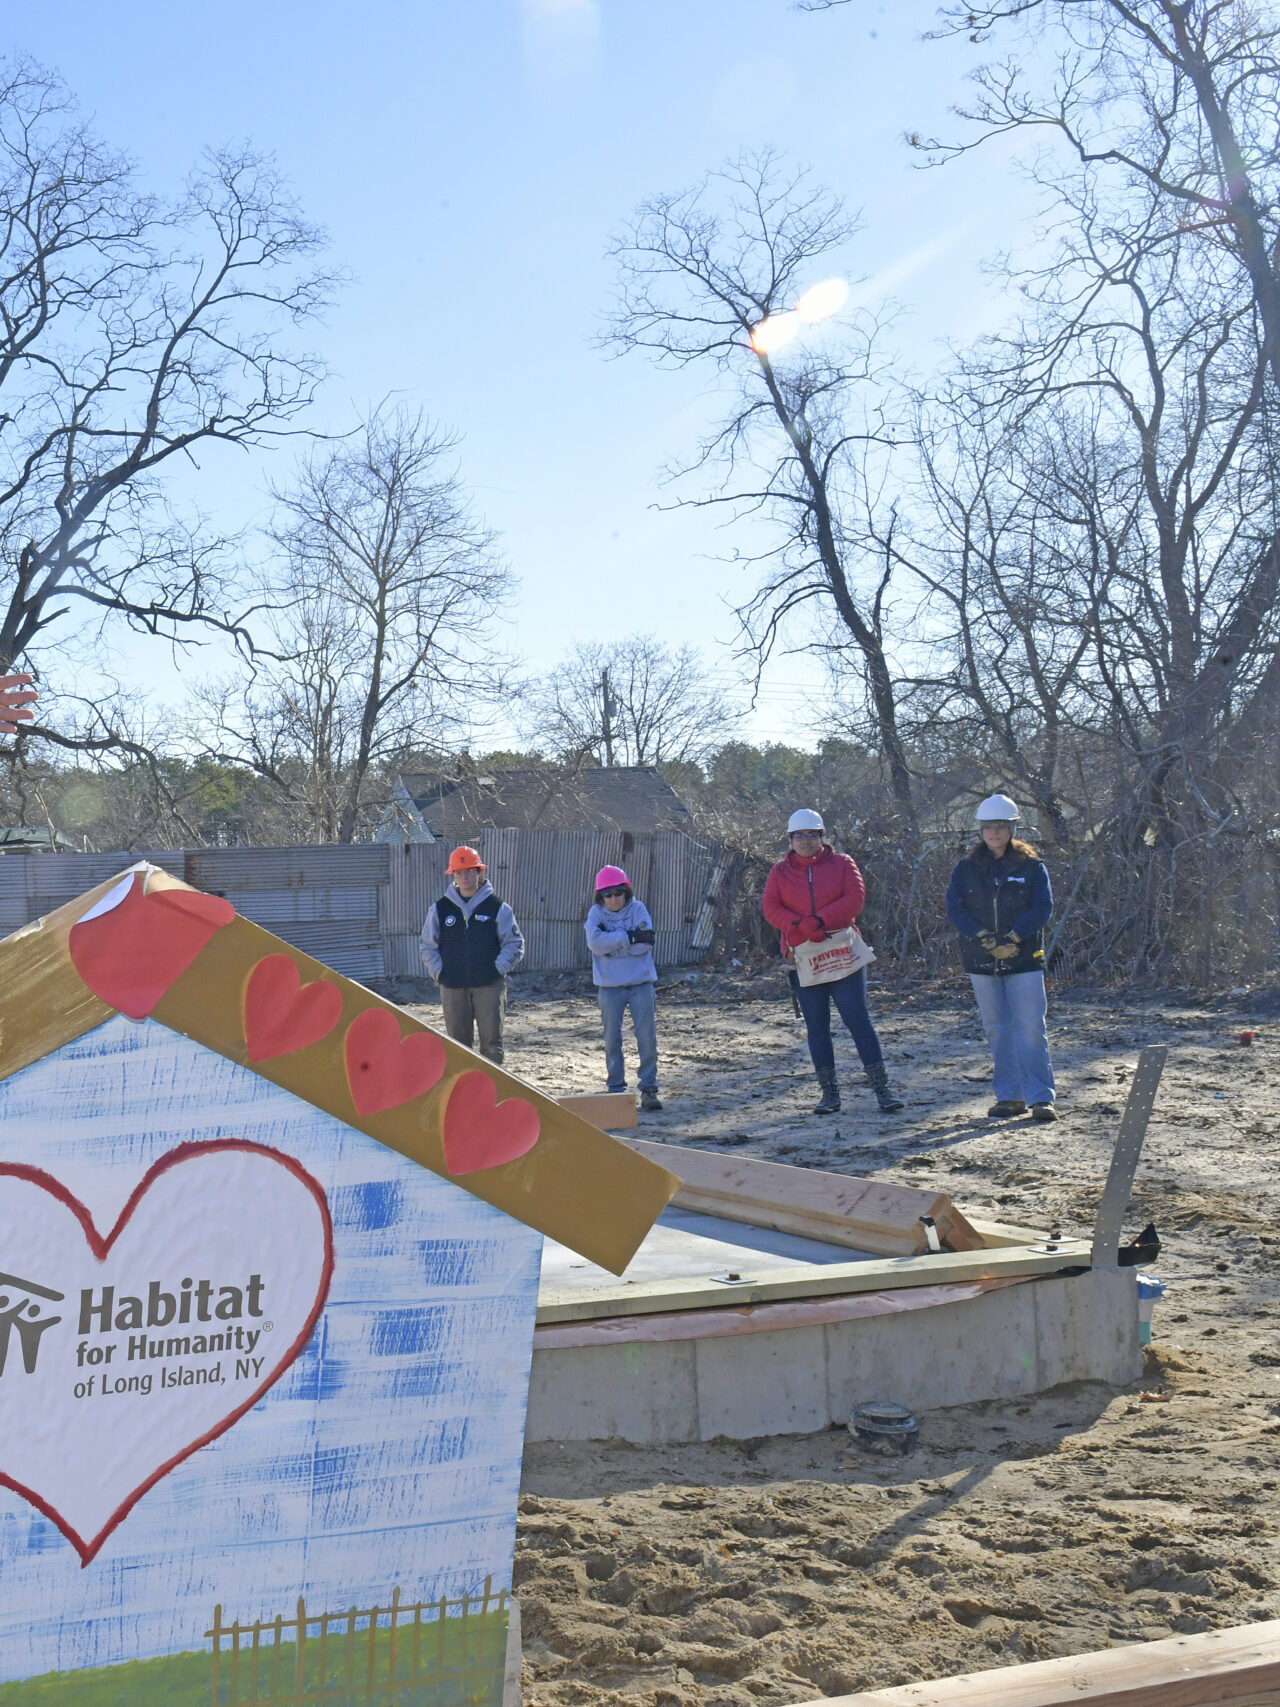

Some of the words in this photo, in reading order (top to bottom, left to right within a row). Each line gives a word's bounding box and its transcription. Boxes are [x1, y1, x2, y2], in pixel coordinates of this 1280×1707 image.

[77, 1274, 265, 1335] Habitat
[76, 1341, 117, 1367] for
[73, 1375, 95, 1399] of
[101, 1374, 153, 1396] Long
[160, 1361, 226, 1389] Island,
[235, 1356, 266, 1380] NY
